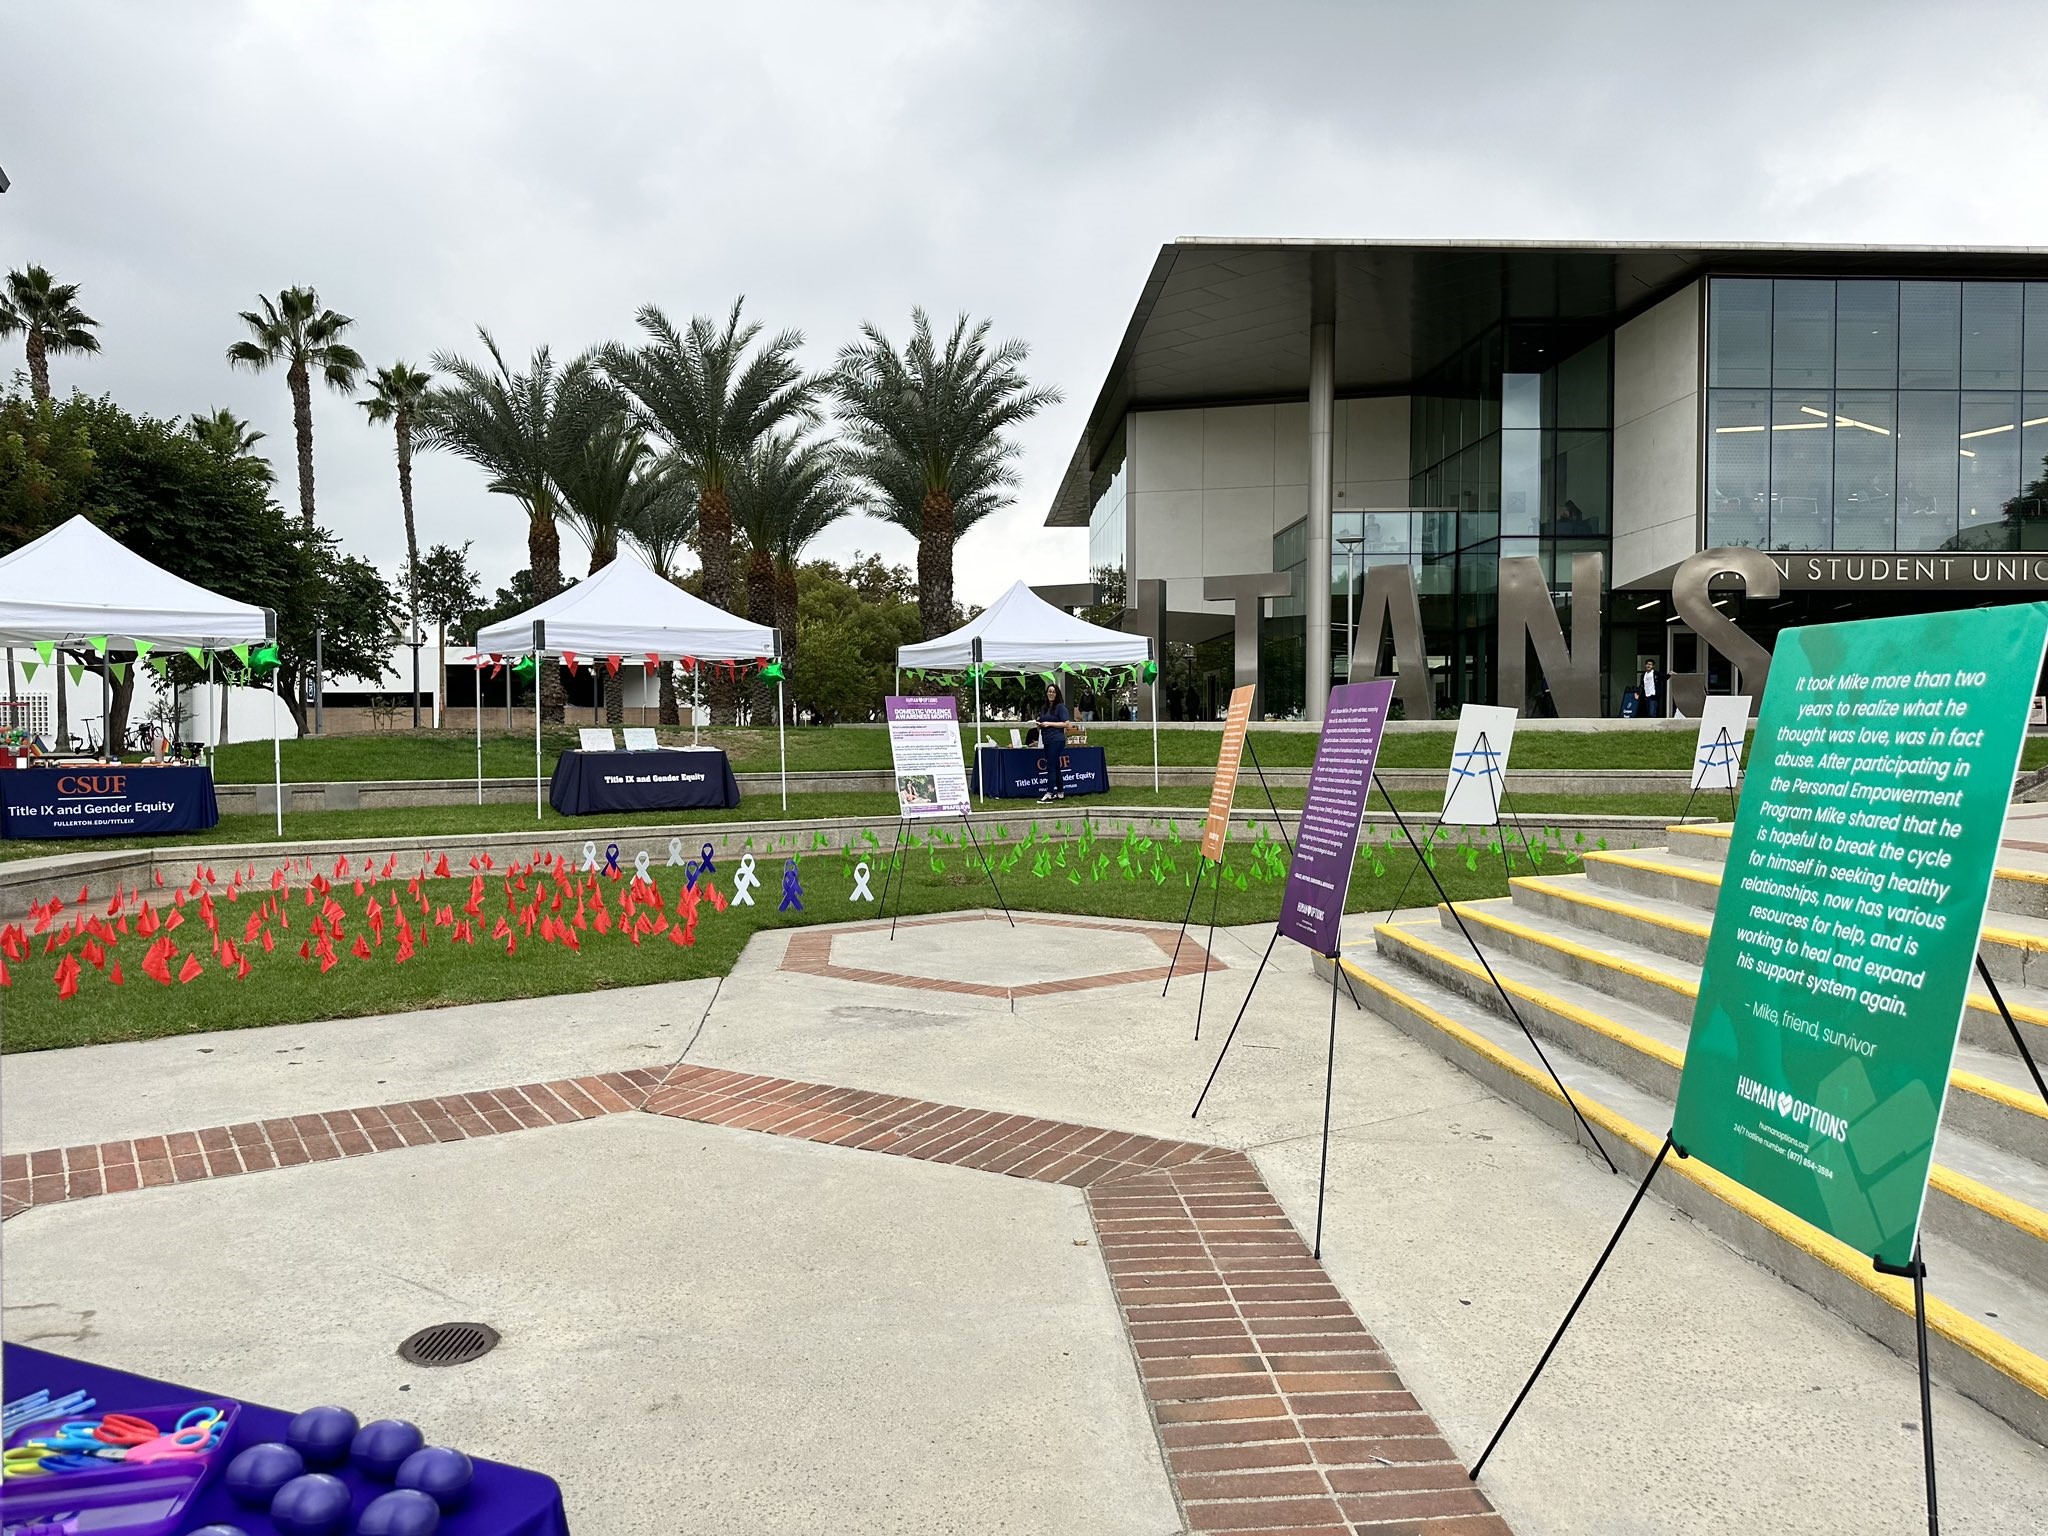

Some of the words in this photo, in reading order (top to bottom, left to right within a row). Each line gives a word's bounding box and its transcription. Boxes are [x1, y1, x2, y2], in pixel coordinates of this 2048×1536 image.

[1807, 558, 1955, 581] STUDENT
[1795, 676, 1806, 691] It
[1806, 674, 1836, 690] took
[1836, 672, 1869, 690] Mike
[1870, 674, 1911, 689] more
[1913, 670, 1952, 688] than
[1954, 669, 1986, 687] two
[1796, 702, 1834, 720] years
[1835, 701, 1850, 716] to
[1851, 699, 1900, 717] realize
[1902, 699, 1943, 716] what
[1943, 698, 1968, 716] he
[1776, 725, 1826, 747] thought
[1827, 730, 1855, 744] was
[1857, 726, 1891, 746] love,
[1894, 730, 1926, 745] was
[1928, 727, 1945, 746] in
[1947, 727, 1985, 748] fact
[604, 775, 624, 784] Title
[625, 775, 635, 783] IX
[636, 774, 651, 783] and
[652, 774, 680, 783] Gender
[681, 773, 706, 782] Equity
[1015, 779, 1031, 788] Title
[1031, 778, 1039, 786] IX
[1076, 771, 1096, 781] Equity
[1774, 751, 1814, 768] abuse.
[1817, 752, 1851, 769] After
[1850, 755, 1951, 780] participating
[1952, 757, 1971, 777] in
[57, 775, 127, 795] CSUF
[1769, 776, 1790, 792] the
[1791, 778, 1849, 797] Personal
[1849, 782, 1963, 807] Empowerment
[8, 806, 37, 817] Title
[41, 805, 54, 816] IX
[57, 804, 82, 815] and
[84, 803, 132, 815] Gender
[134, 801, 175, 813] Equity
[53, 818, 135, 827] FULLERTON.EDU/TITLEIX
[1759, 800, 1812, 823] Program
[1813, 806, 1846, 825] Mike
[1847, 809, 1901, 831] shared
[1902, 815, 1937, 836] that
[1938, 818, 1962, 838] he
[1756, 824, 1767, 841] is
[1768, 827, 1817, 849] hopeful
[1818, 834, 1833, 851] to
[1834, 835, 1877, 857] break
[1878, 841, 1905, 862] the
[1906, 847, 1952, 869] cycle
[1748, 849, 1766, 866] for
[1766, 853, 1814, 875] himself
[1813, 859, 1827, 877] in
[1829, 865, 1886, 893] seeking
[1886, 871, 1951, 904] healthy
[1740, 876, 1820, 907] relationships,
[1822, 892, 1854, 911] now
[1854, 895, 1884, 918] has
[1886, 904, 1947, 931] various
[1748, 904, 1809, 930] resources
[1810, 915, 1831, 935] for
[1831, 920, 1867, 946] help,
[1869, 931, 1903, 952] and
[1903, 935, 1920, 956] is
[1736, 927, 1784, 956] working
[1784, 938, 1798, 956] to
[1799, 941, 1832, 964] heal
[1832, 952, 1863, 973] and
[1864, 961, 1927, 990] expand
[1736, 951, 1755, 970] his
[1755, 960, 1805, 986] support
[1805, 974, 1857, 1002] system
[1859, 990, 1908, 1017] again.
[1752, 1000, 1779, 1026] Mike,
[1781, 1009, 1820, 1041] friend,
[1822, 1027, 1878, 1058] survivor
[1736, 1074, 1777, 1111] HUMAN
[1792, 1100, 1849, 1142] OPTIONS
[1758, 1120, 1810, 1153] humanoptions.org
